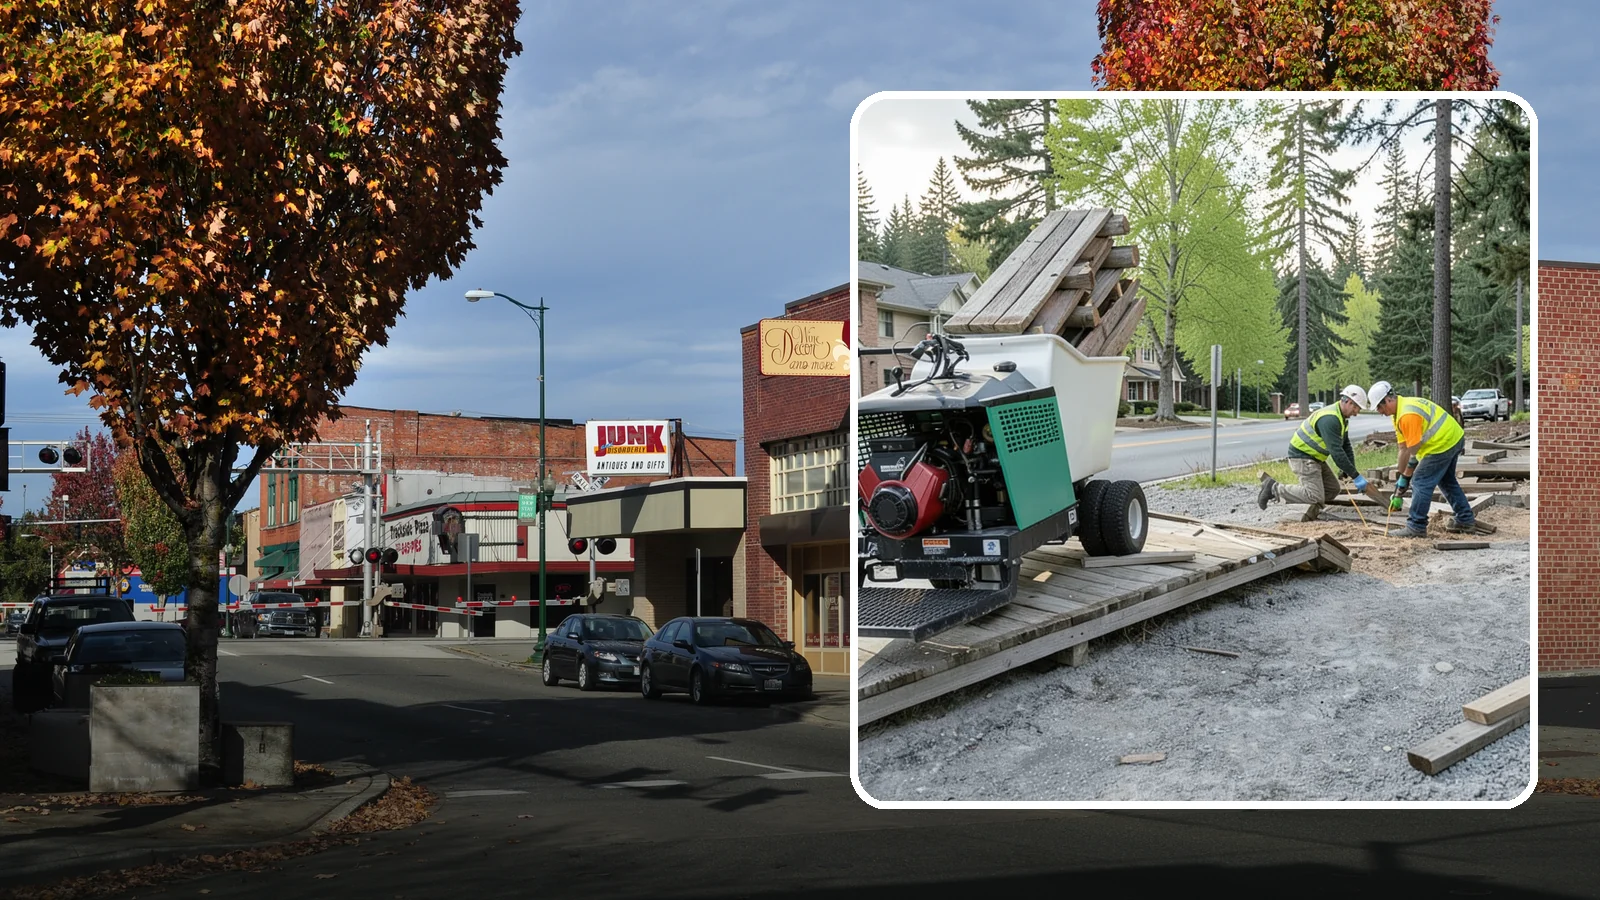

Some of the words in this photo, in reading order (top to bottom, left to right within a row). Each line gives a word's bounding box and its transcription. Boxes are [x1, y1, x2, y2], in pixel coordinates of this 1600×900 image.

[595, 425, 666, 457] JUNK
[607, 446, 646, 454] DISORDERLY
[597, 461, 628, 470] ANTIQUES
[631, 461, 644, 470] AND
[647, 460, 665, 469] GIFTS
[390, 521, 413, 539] Trackside
[414, 519, 429, 534] Pizza
